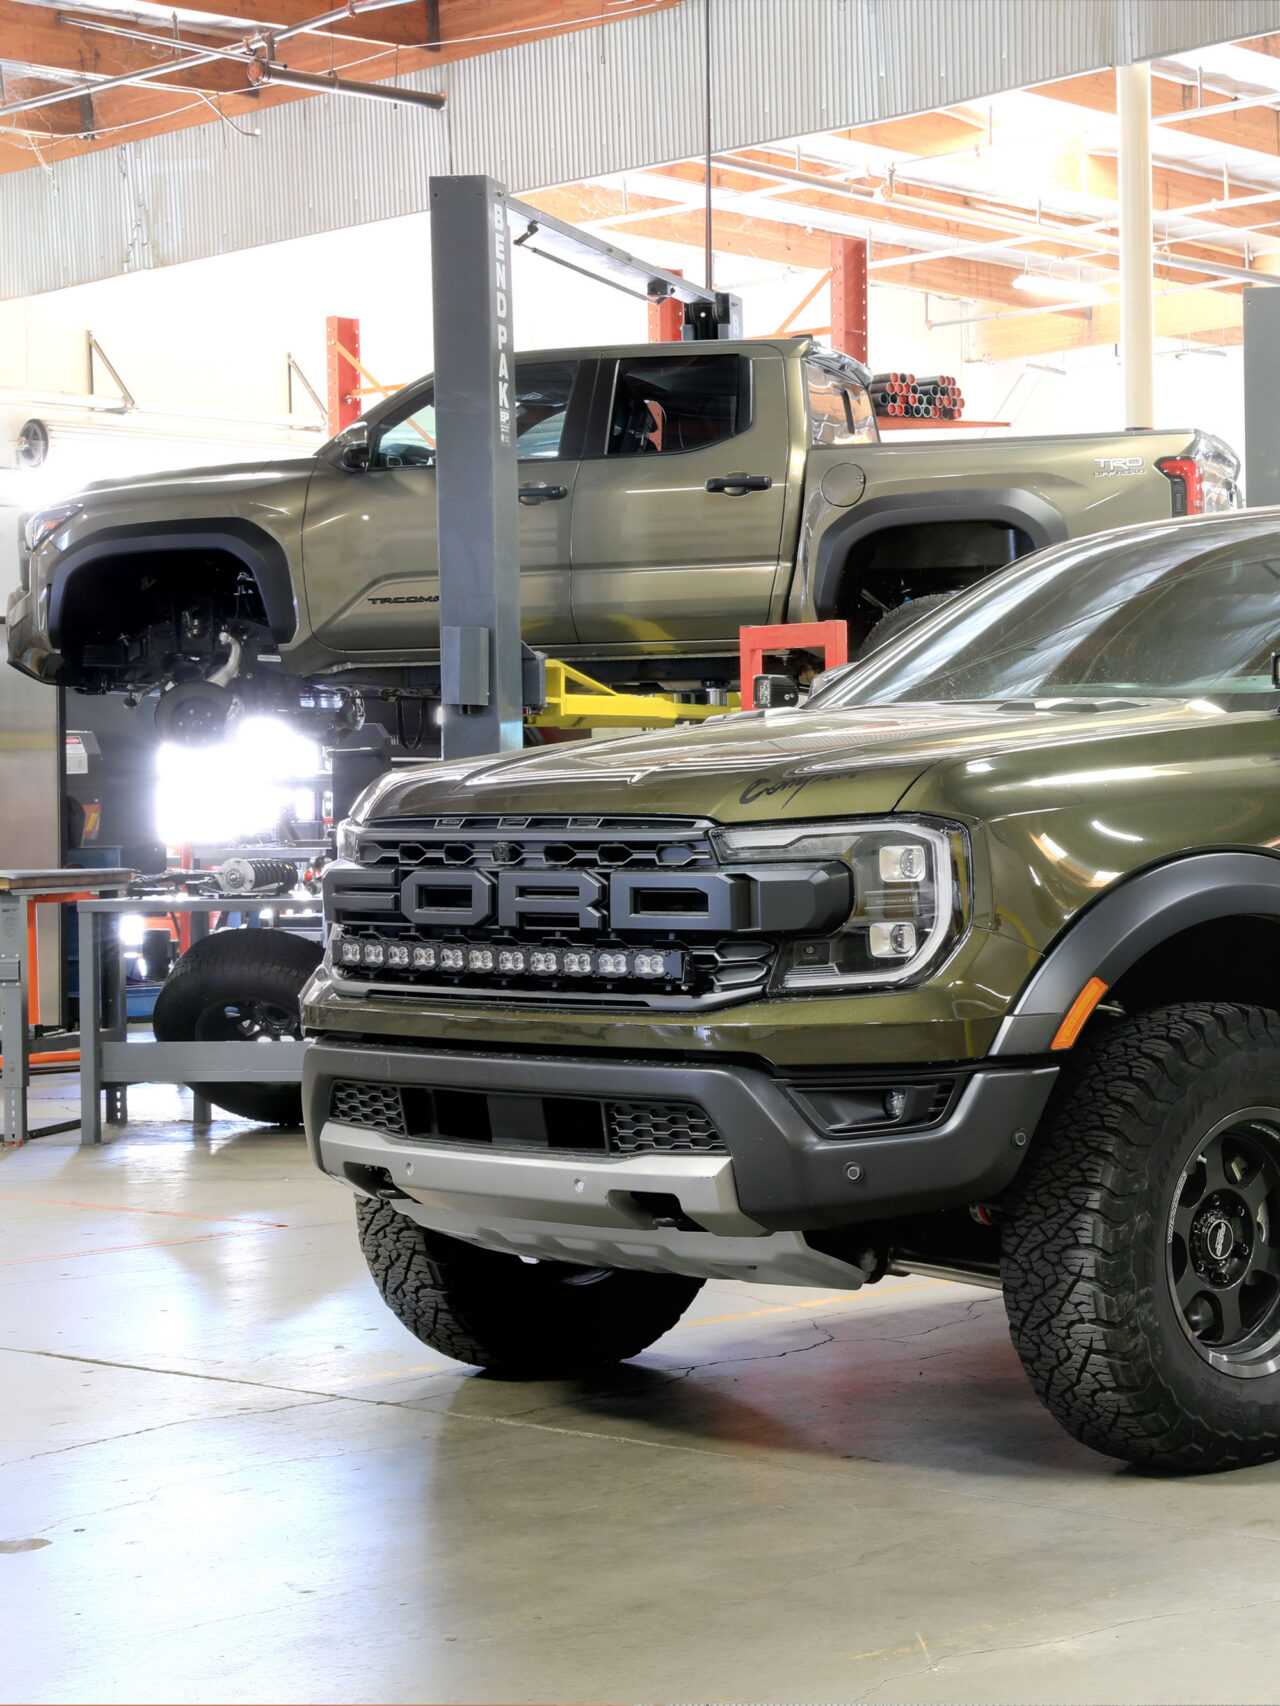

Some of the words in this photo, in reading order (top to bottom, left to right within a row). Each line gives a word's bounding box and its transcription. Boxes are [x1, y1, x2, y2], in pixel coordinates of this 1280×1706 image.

[494, 203, 510, 409] BENDPAK
[1094, 456, 1143, 471] TRD
[322, 866, 740, 932] FORD
